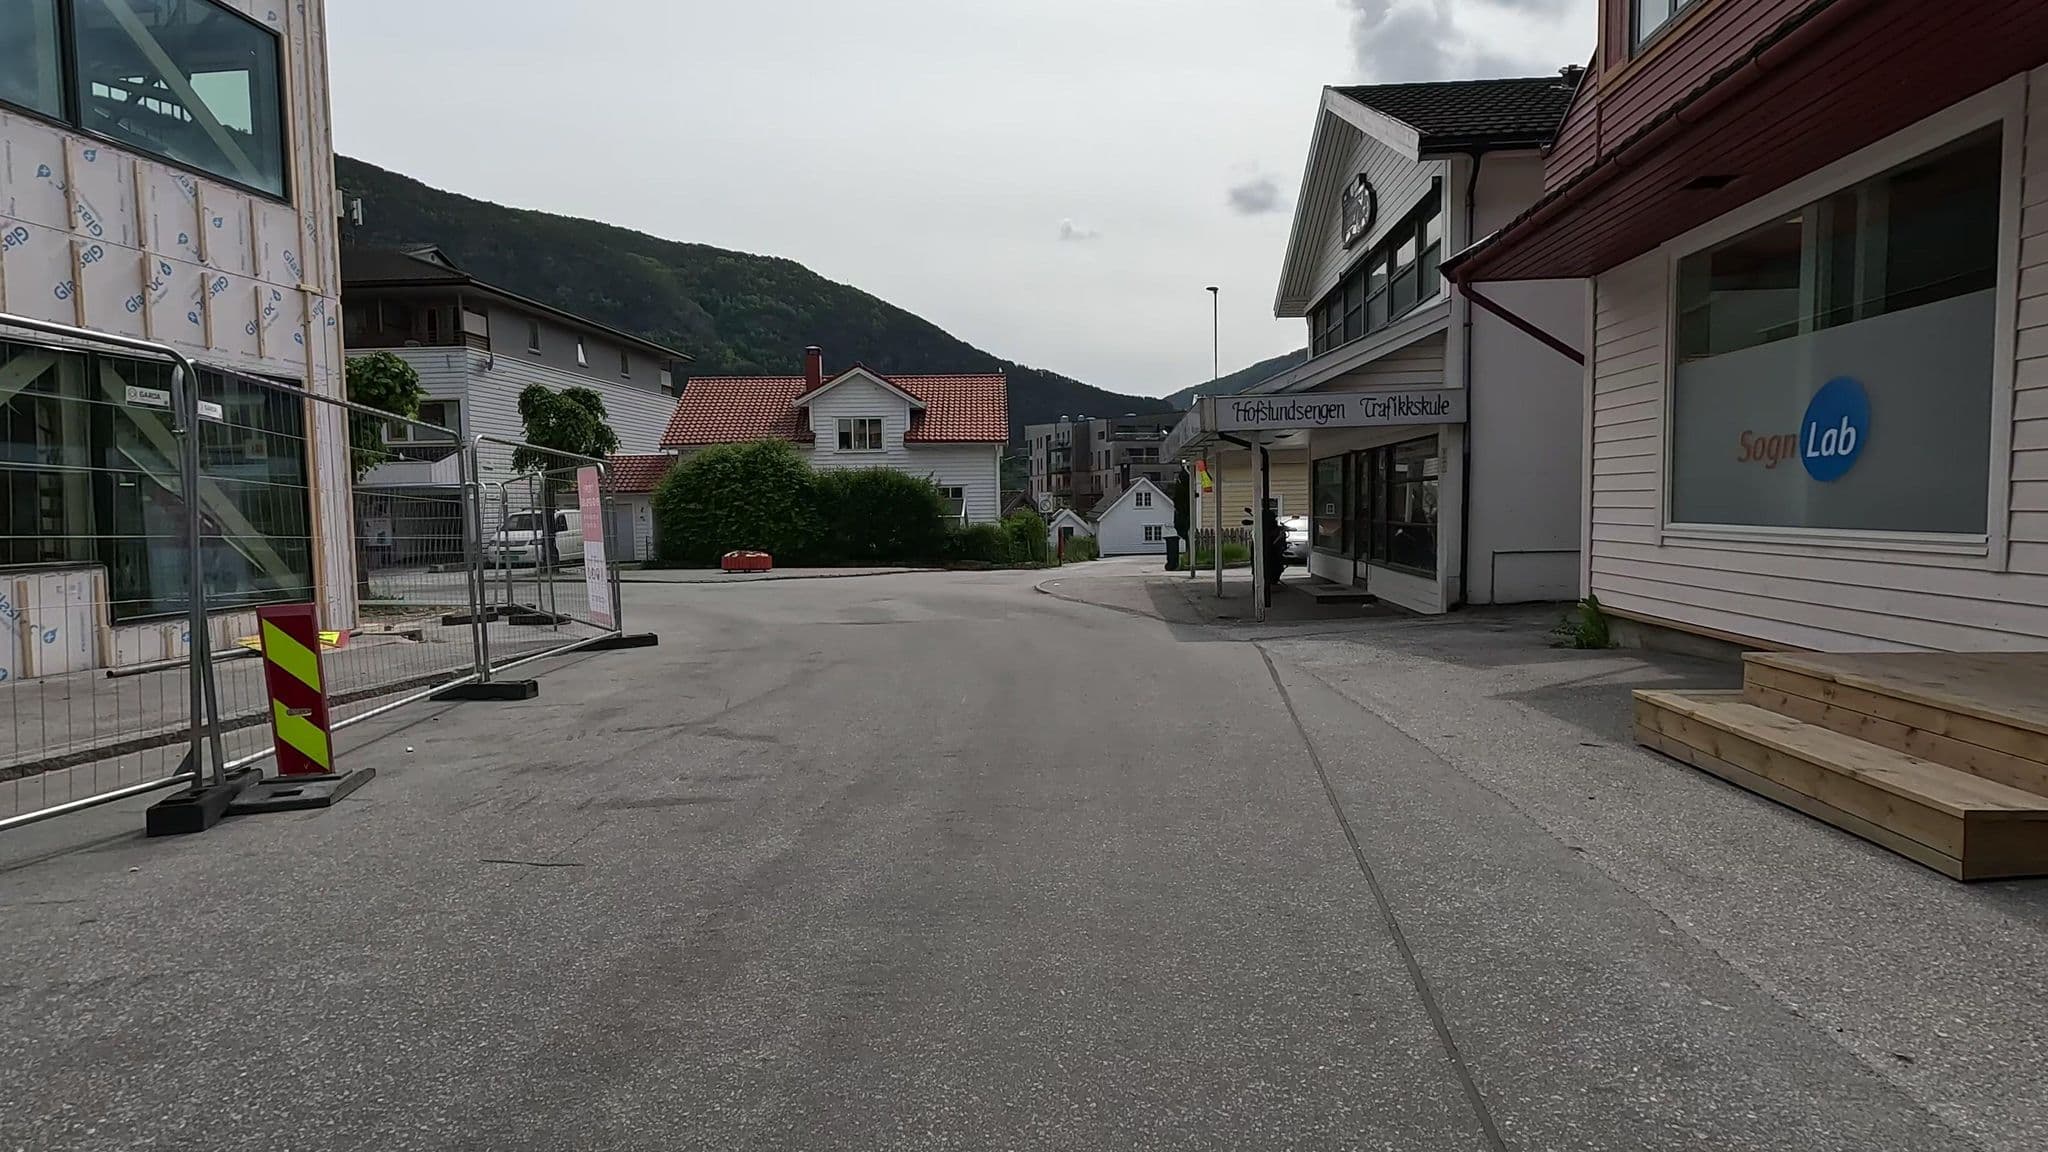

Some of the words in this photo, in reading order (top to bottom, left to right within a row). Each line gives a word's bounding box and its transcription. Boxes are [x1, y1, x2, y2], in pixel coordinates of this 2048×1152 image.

[1231, 400, 1345, 425] Hofslundsengen
[1359, 393, 1450, 421] Trafikkskule
[1737, 429, 1797, 470] Sogn
[1806, 414, 1857, 459] Lab
